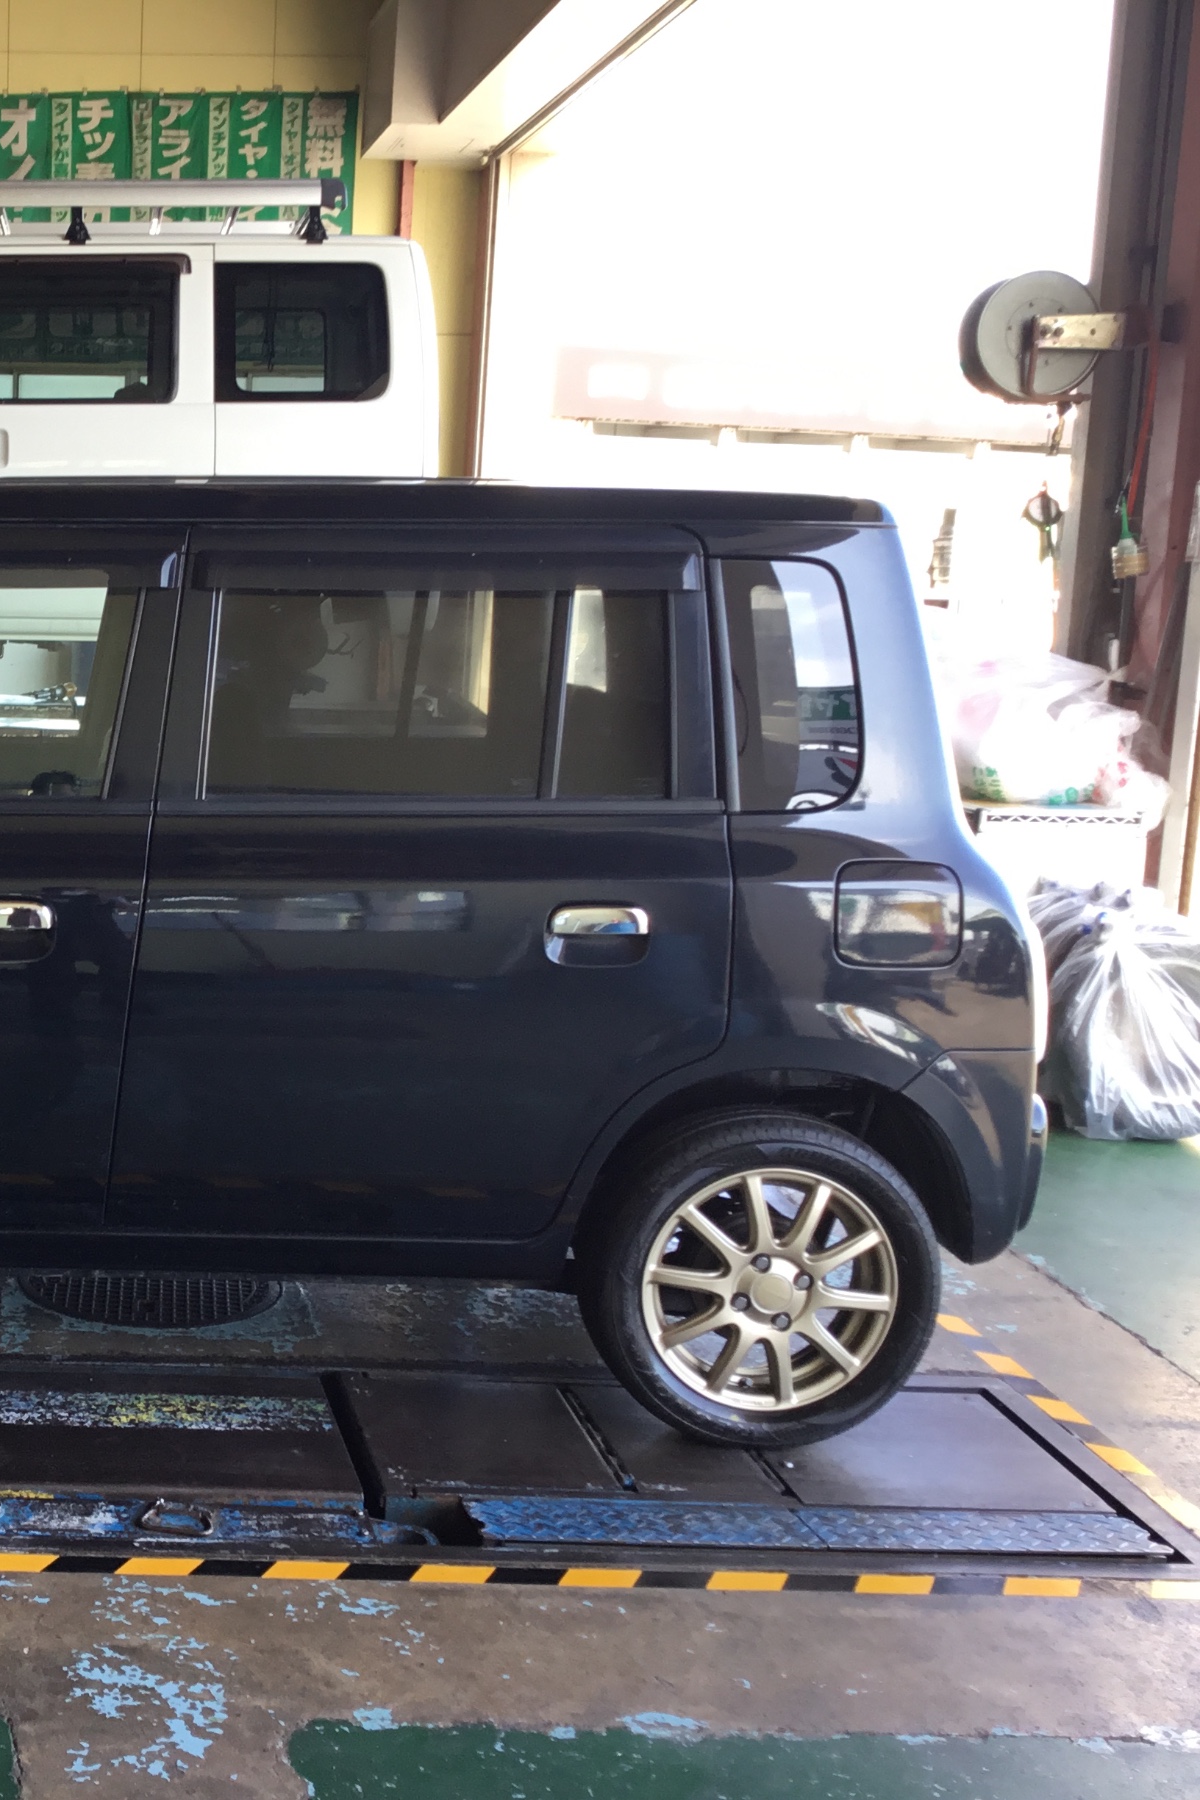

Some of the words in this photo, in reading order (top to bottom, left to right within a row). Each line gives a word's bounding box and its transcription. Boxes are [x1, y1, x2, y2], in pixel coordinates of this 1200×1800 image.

[211, 100, 229, 179] インチアッ
